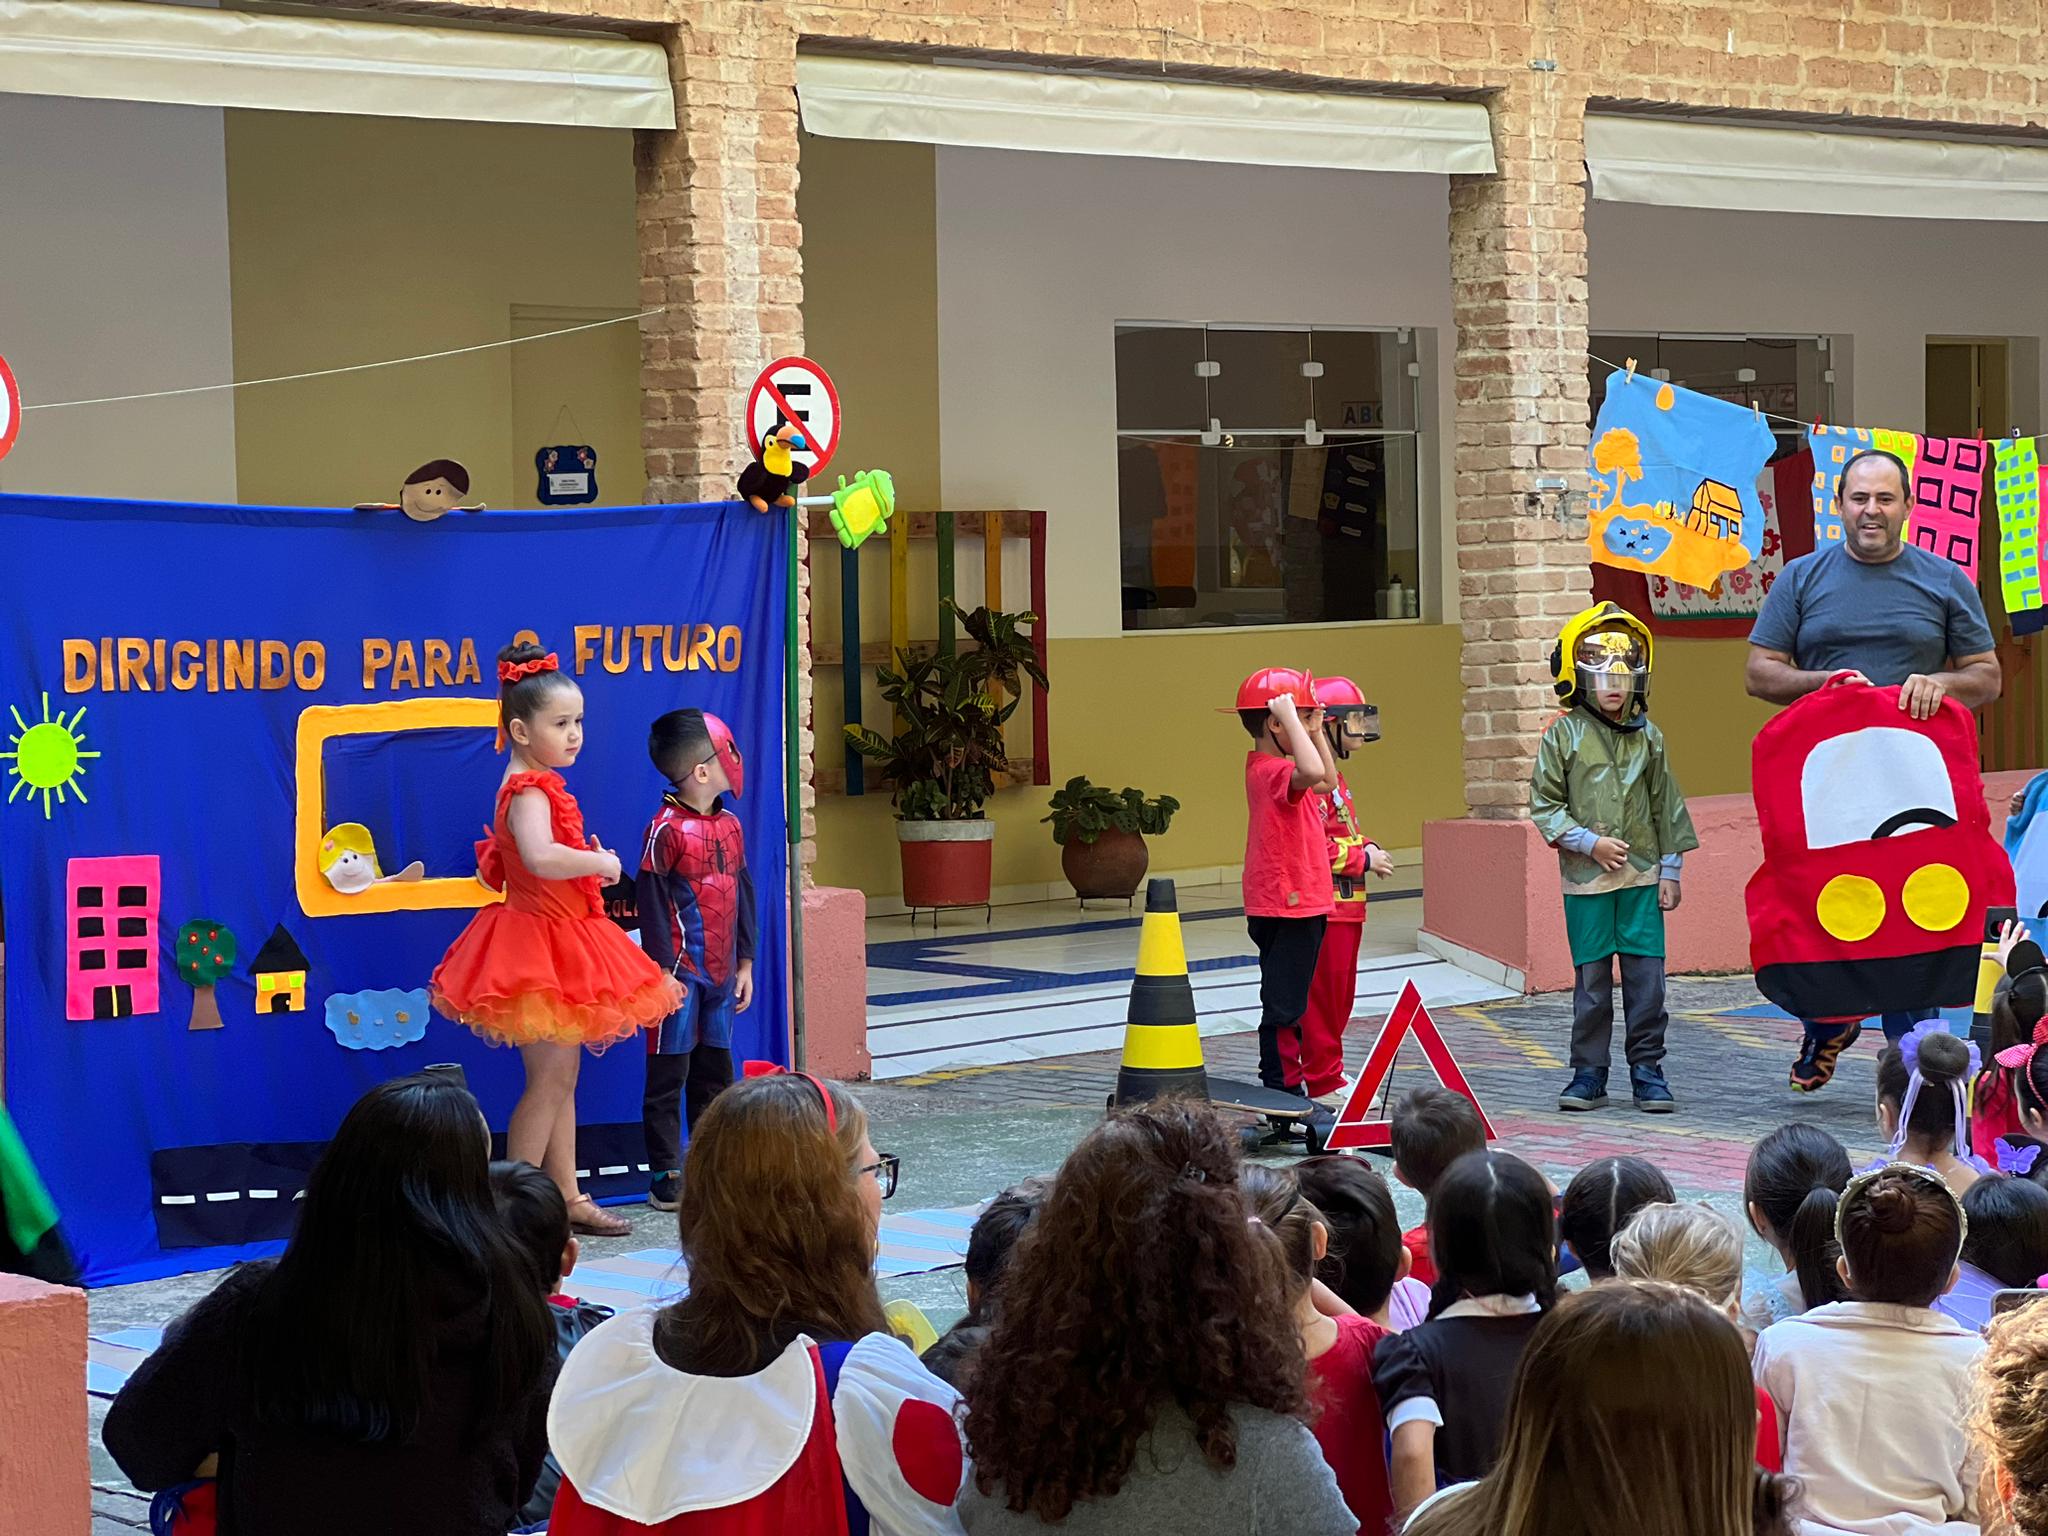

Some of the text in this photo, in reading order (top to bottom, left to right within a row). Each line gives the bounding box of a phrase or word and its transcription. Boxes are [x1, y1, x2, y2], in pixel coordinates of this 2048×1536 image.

[776, 383, 811, 451] E
[63, 623, 742, 693] DIRIGINDO PARA FUTURO
